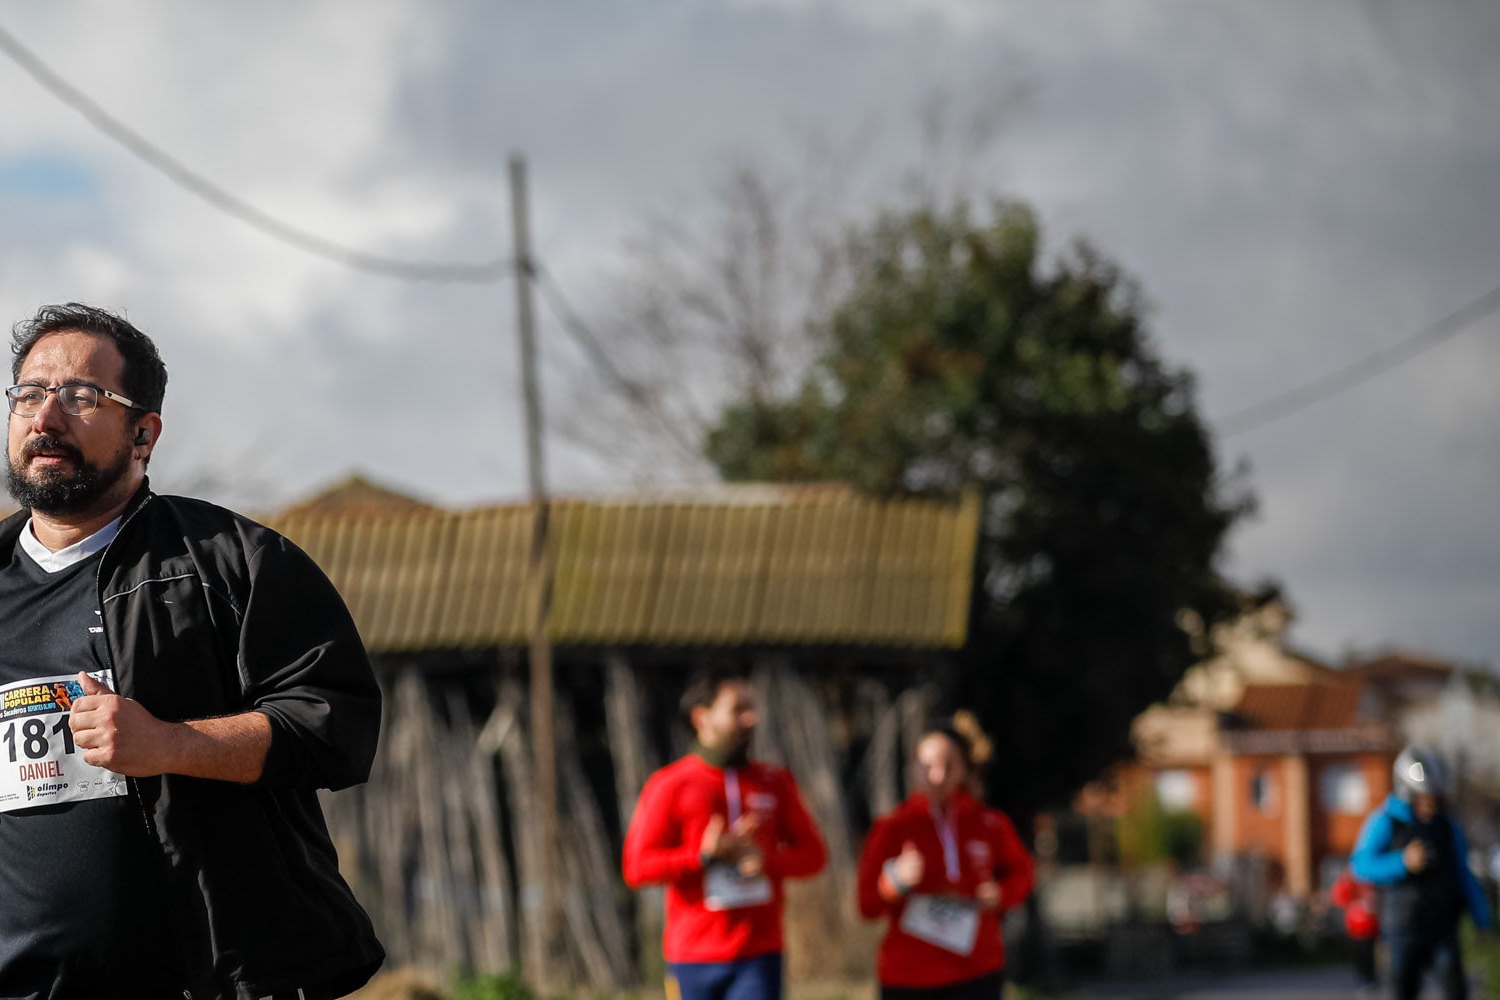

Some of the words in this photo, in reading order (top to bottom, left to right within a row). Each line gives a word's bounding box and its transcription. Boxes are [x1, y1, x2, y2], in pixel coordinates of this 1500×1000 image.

[5, 685, 50, 701] CARRERA
[5, 695, 50, 709] POPULAR
[3, 715, 75, 763] 181
[19, 760, 65, 782] DANIEL
[37, 782, 69, 792] olimpo
